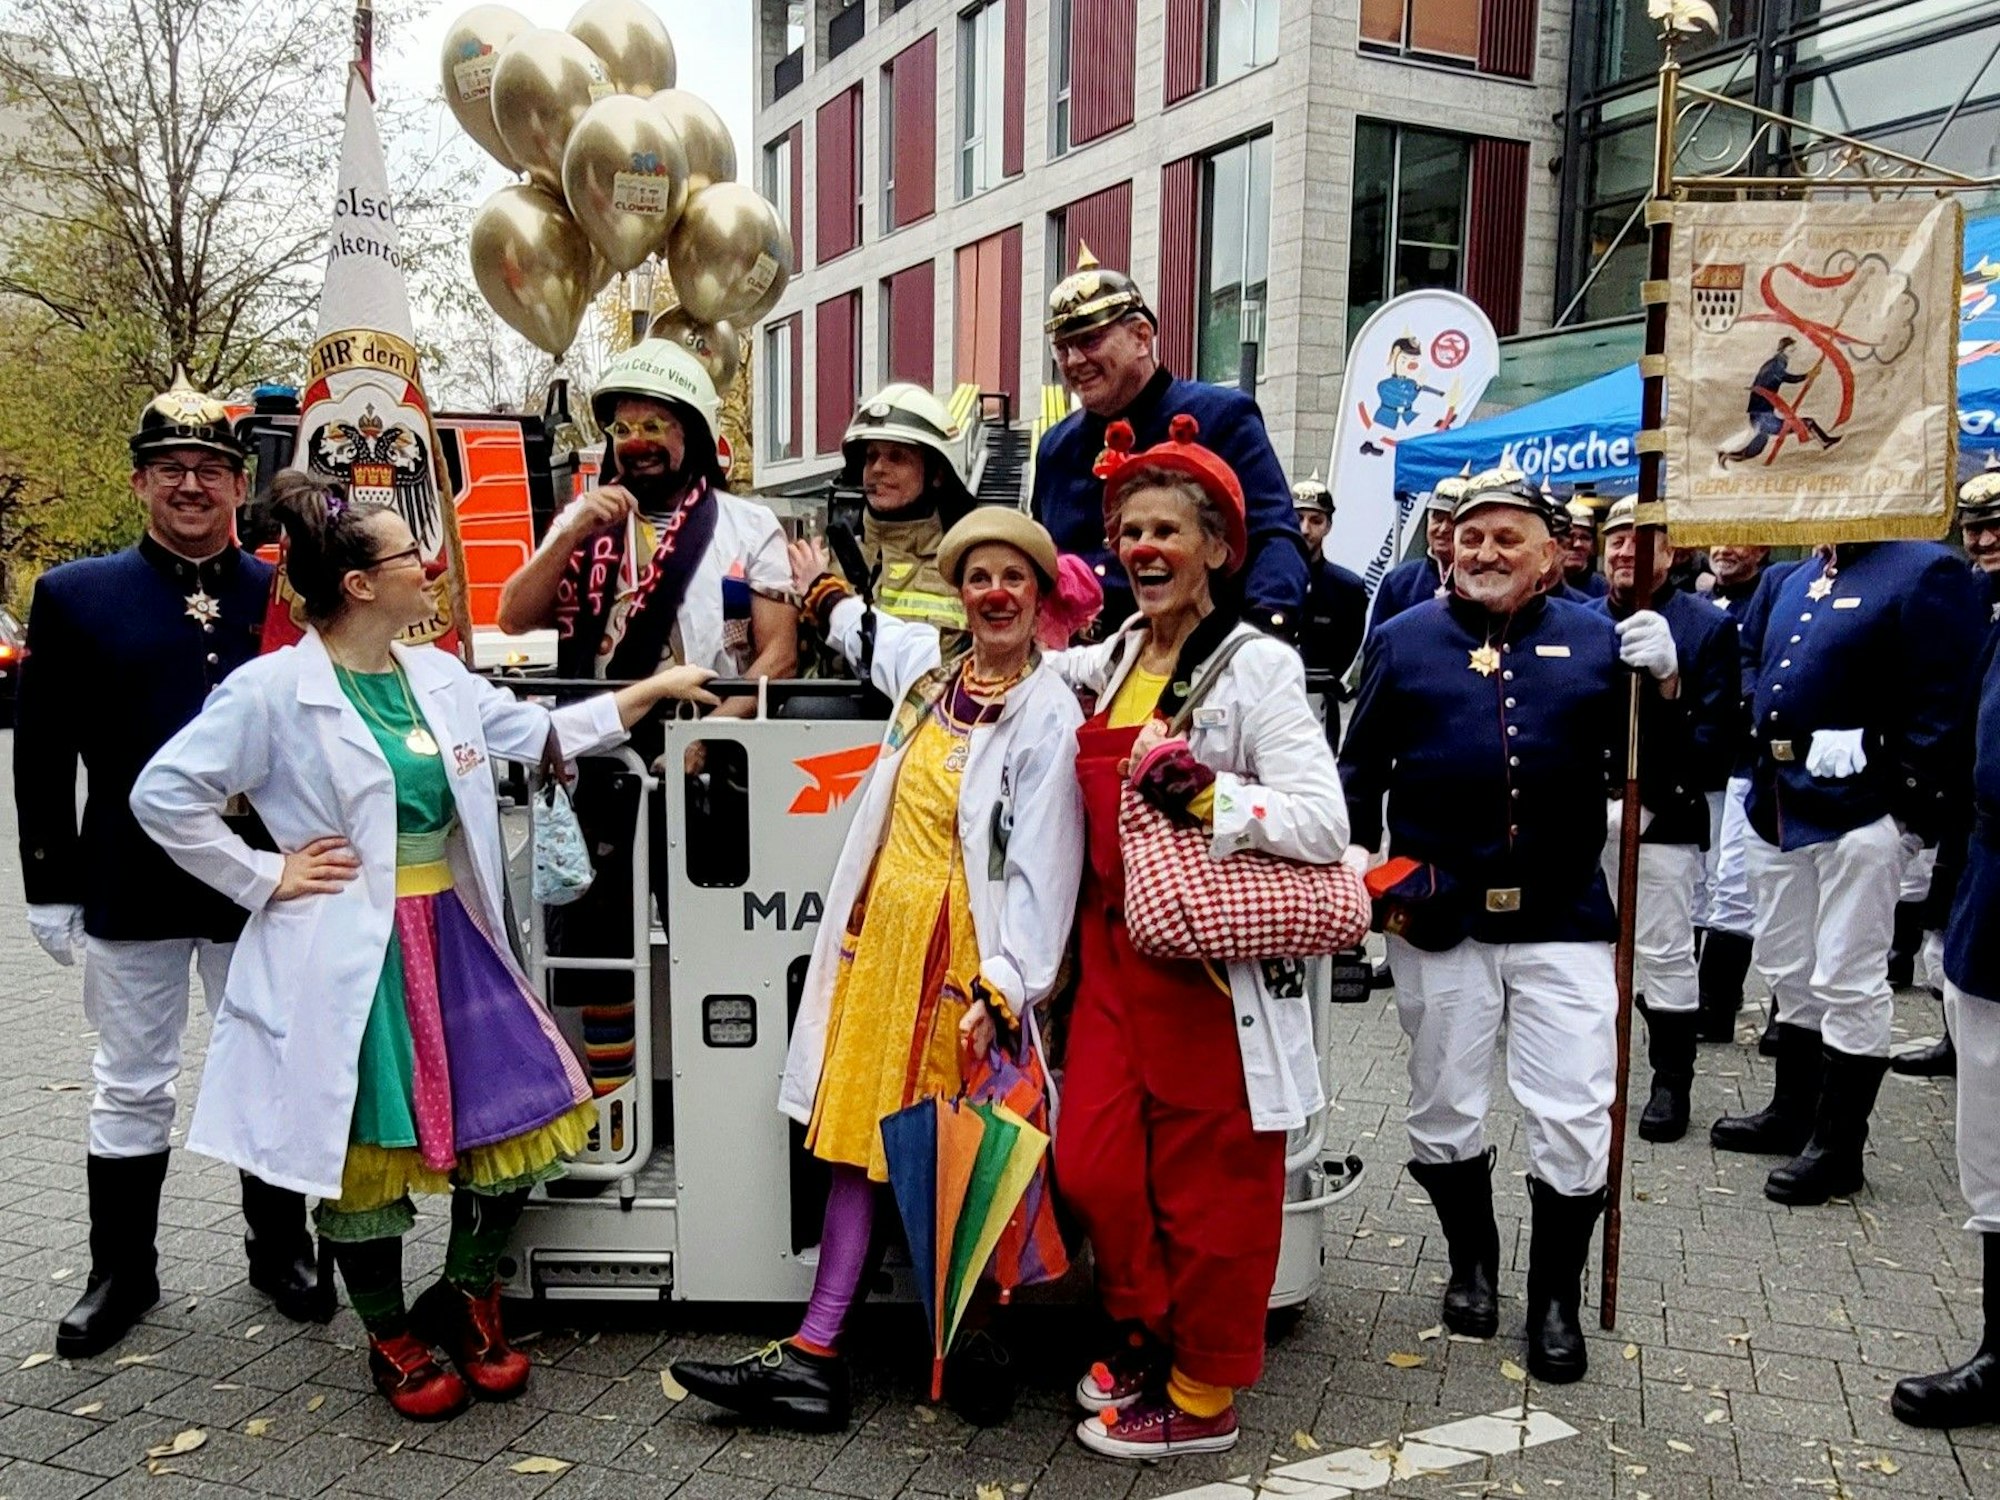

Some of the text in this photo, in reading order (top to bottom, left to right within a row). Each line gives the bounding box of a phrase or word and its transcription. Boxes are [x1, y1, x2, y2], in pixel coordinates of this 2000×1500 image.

[363, 341, 410, 376] dem
[1500, 430, 1630, 476] Kölsche
[587, 536, 619, 616] der
[744, 891, 824, 931] MA
